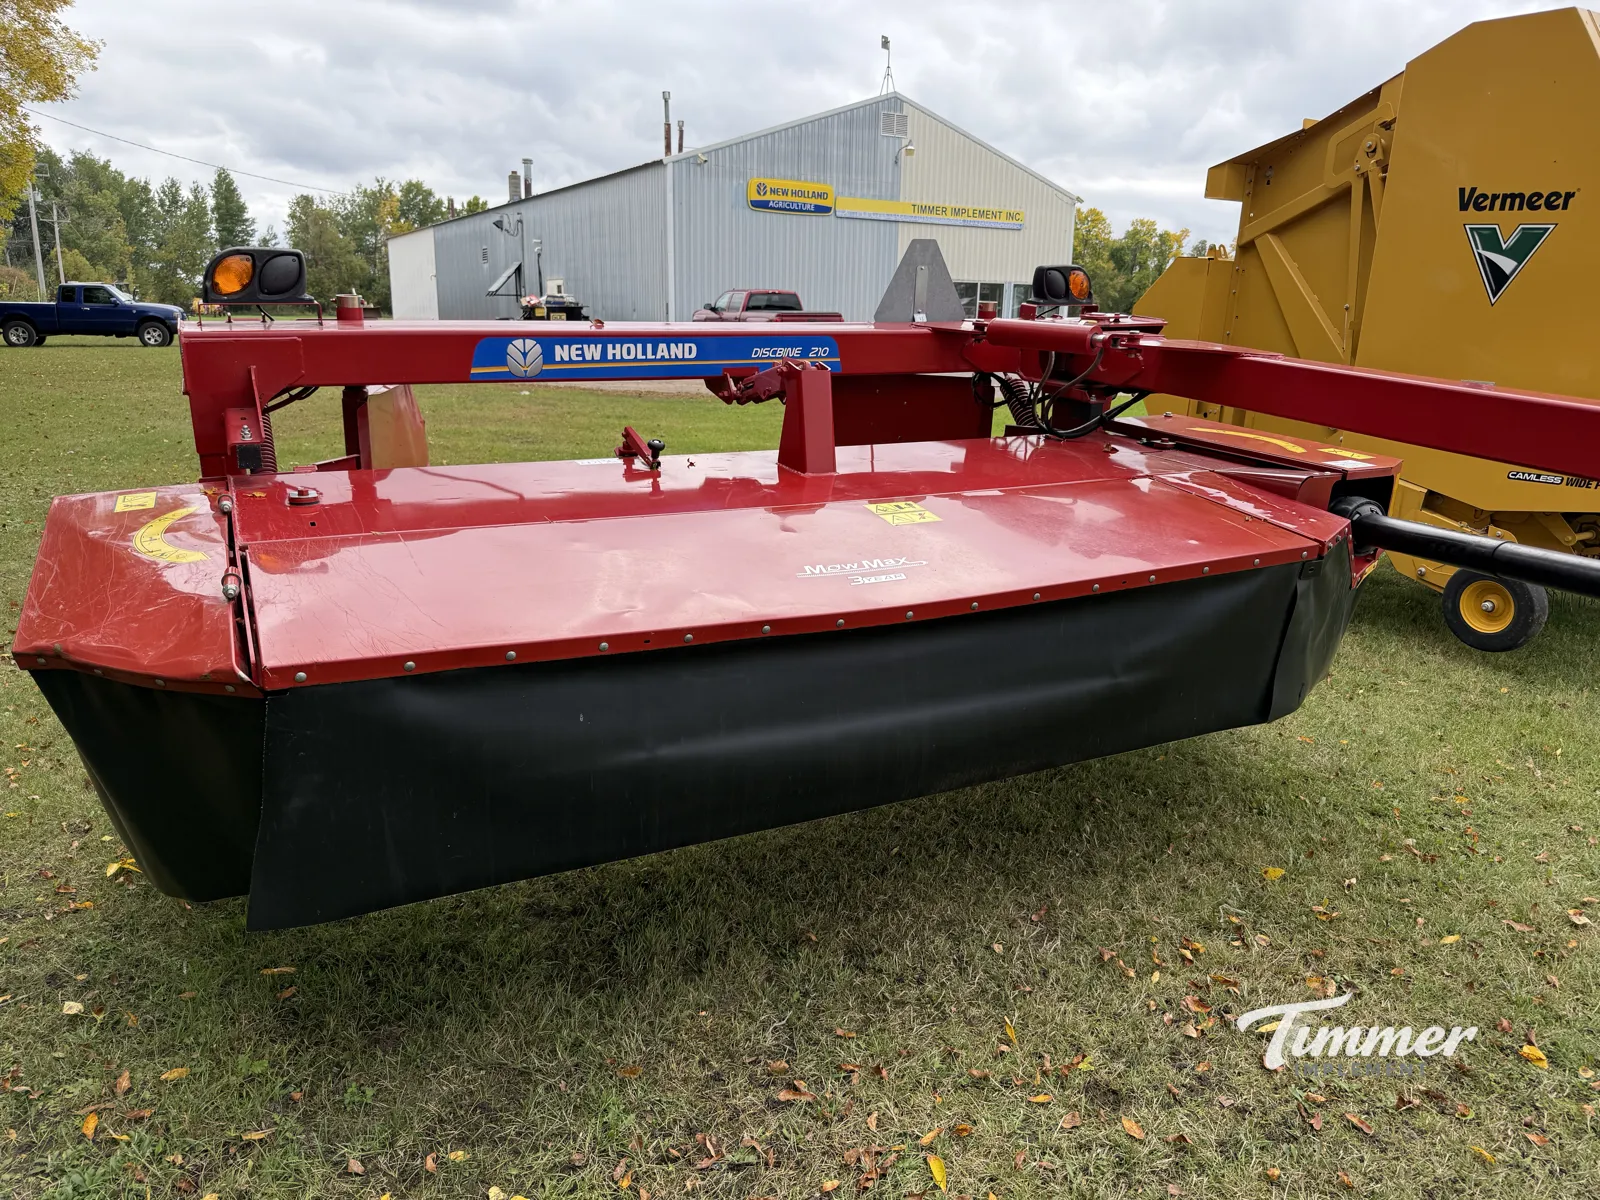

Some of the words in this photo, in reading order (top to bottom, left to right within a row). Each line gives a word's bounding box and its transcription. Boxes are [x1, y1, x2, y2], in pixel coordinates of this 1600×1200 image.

[769, 186, 790, 197] NEW
[790, 188, 829, 201] HOLLAND
[1458, 187, 1576, 212] Vermeer
[768, 200, 815, 212] AGRICULTURE
[911, 204, 948, 217] TIMMER
[950, 207, 1003, 220] IMPLEMENT
[1005, 211, 1024, 223] INC.
[554, 344, 602, 362] NEW
[607, 343, 698, 360] HOLLAND
[751, 347, 803, 358] DISCBINE
[808, 347, 830, 357] 210
[1508, 471, 1563, 485] CAMLESS
[1565, 477, 1593, 489] WIDE
[803, 562, 858, 576] Mow
[861, 556, 908, 570] Max
